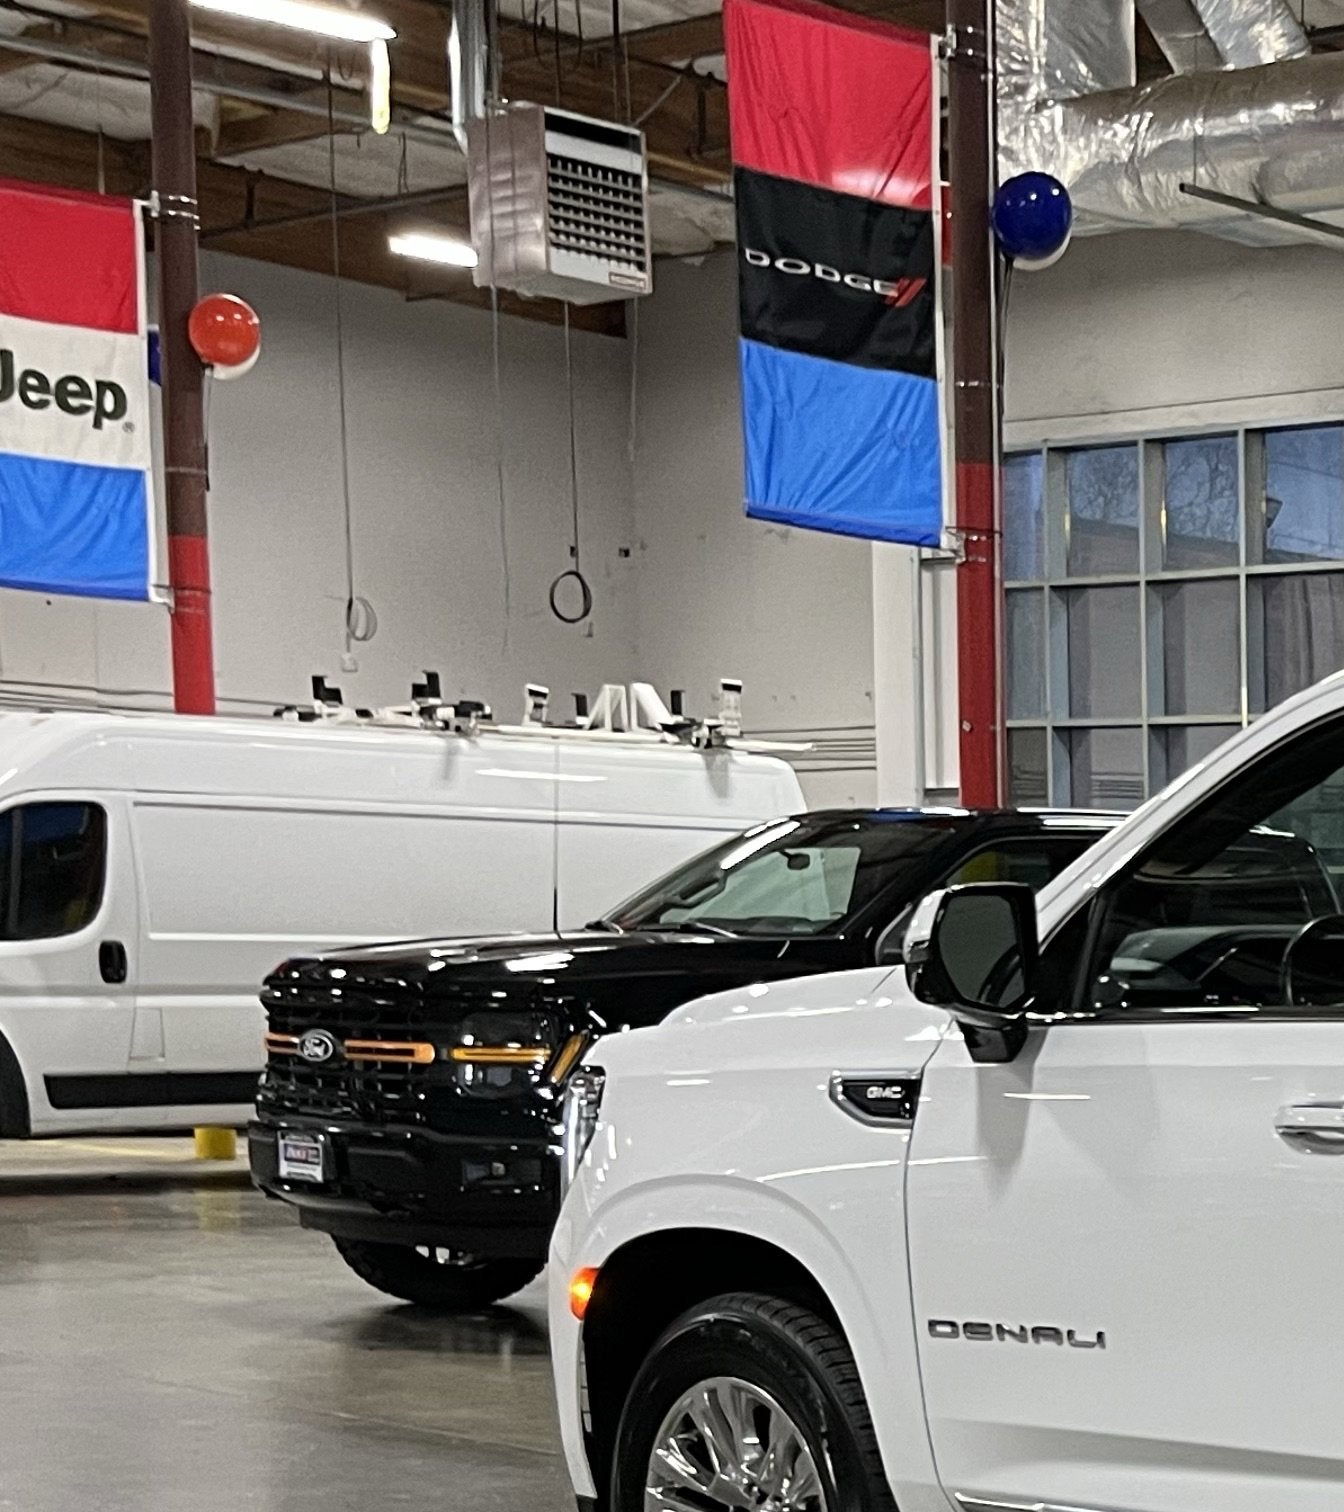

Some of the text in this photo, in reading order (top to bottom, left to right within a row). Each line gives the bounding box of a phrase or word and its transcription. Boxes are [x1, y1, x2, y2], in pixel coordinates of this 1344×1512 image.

[745, 248, 899, 297] DODGE
[0, 349, 128, 430] Jeep
[928, 1319, 1106, 1349] DENALI
